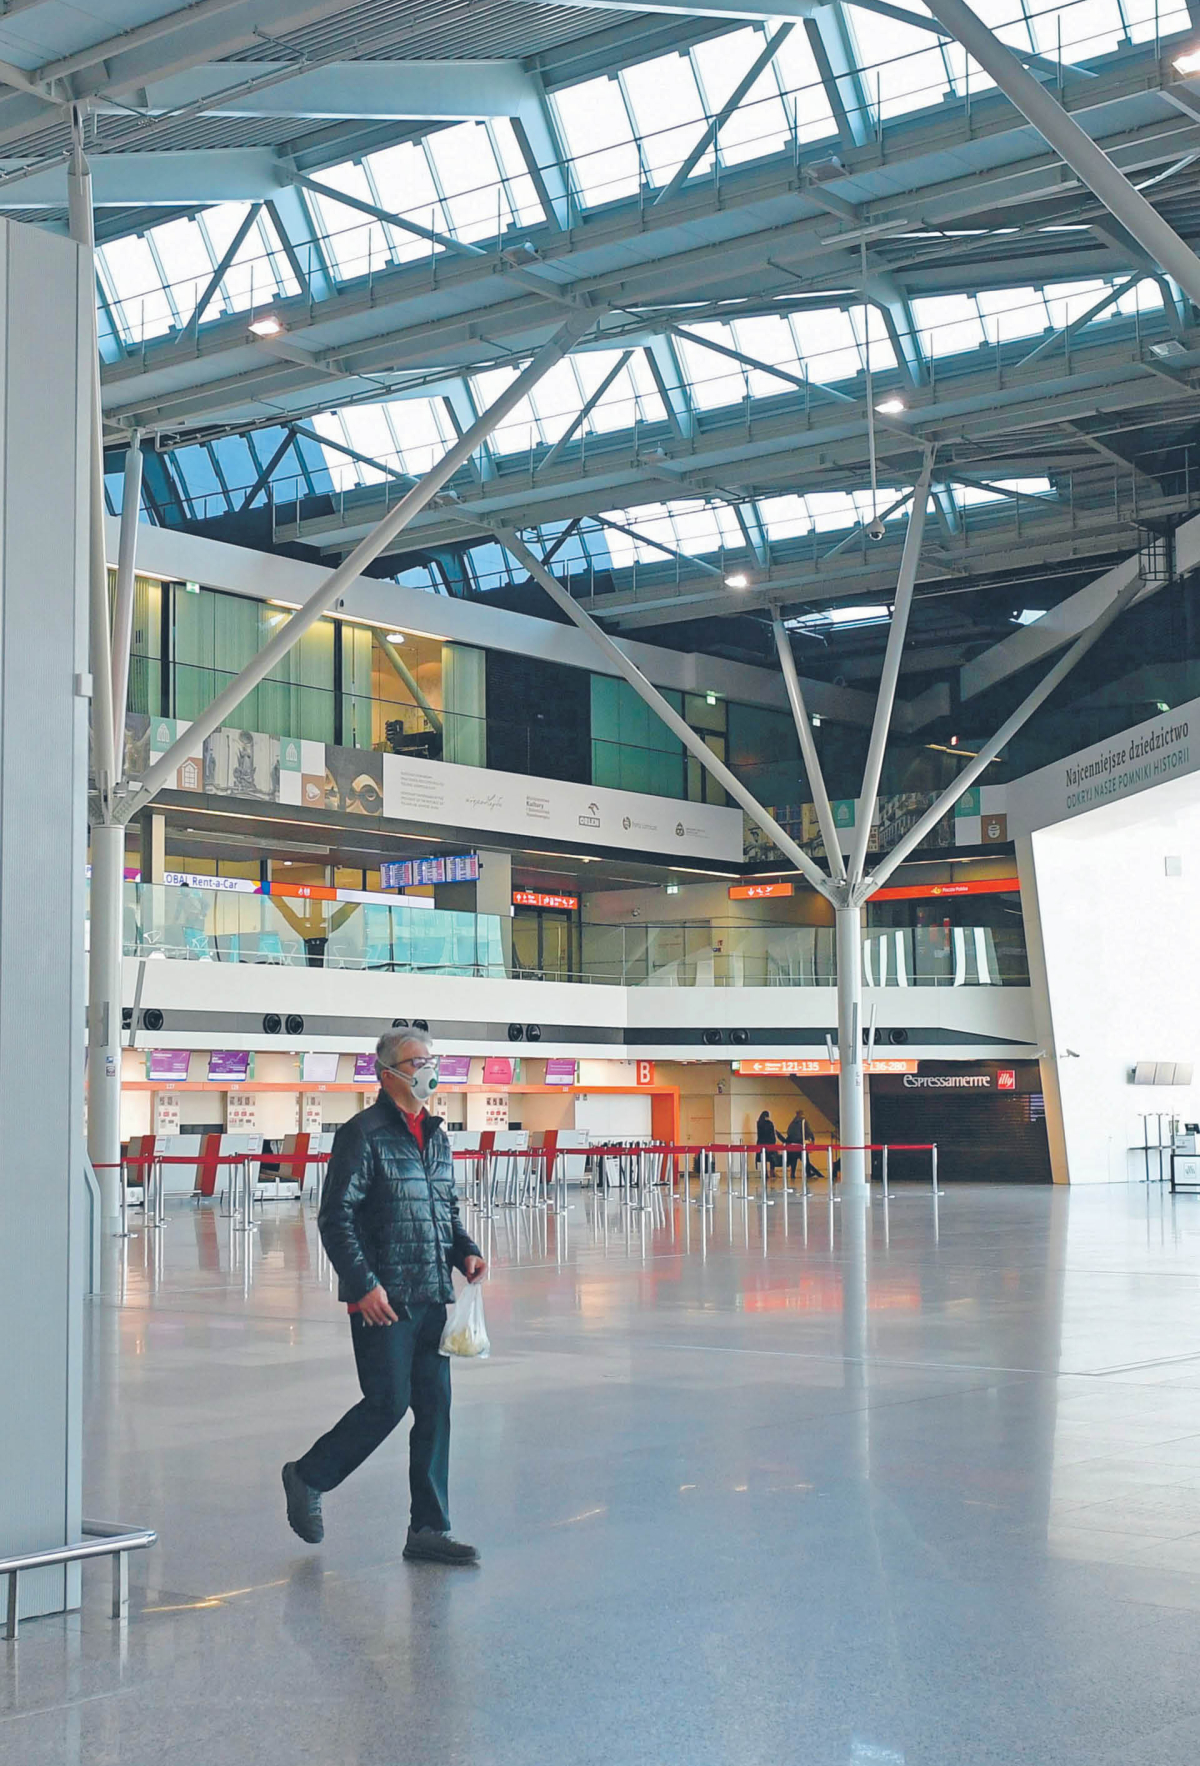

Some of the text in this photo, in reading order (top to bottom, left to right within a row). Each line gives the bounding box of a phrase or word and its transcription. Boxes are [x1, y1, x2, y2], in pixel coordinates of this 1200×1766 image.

[1065, 722, 1189, 788] Najcenniejsze dziedzictwo
[1066, 747, 1190, 809] ODKRYJ NASZE POMNIKI HISTORII
[192, 876, 238, 889] Rent-a-Car
[640, 1062, 650, 1083] B
[782, 1062, 819, 1071] 121-135
[998, 1071, 1013, 1086] illy
